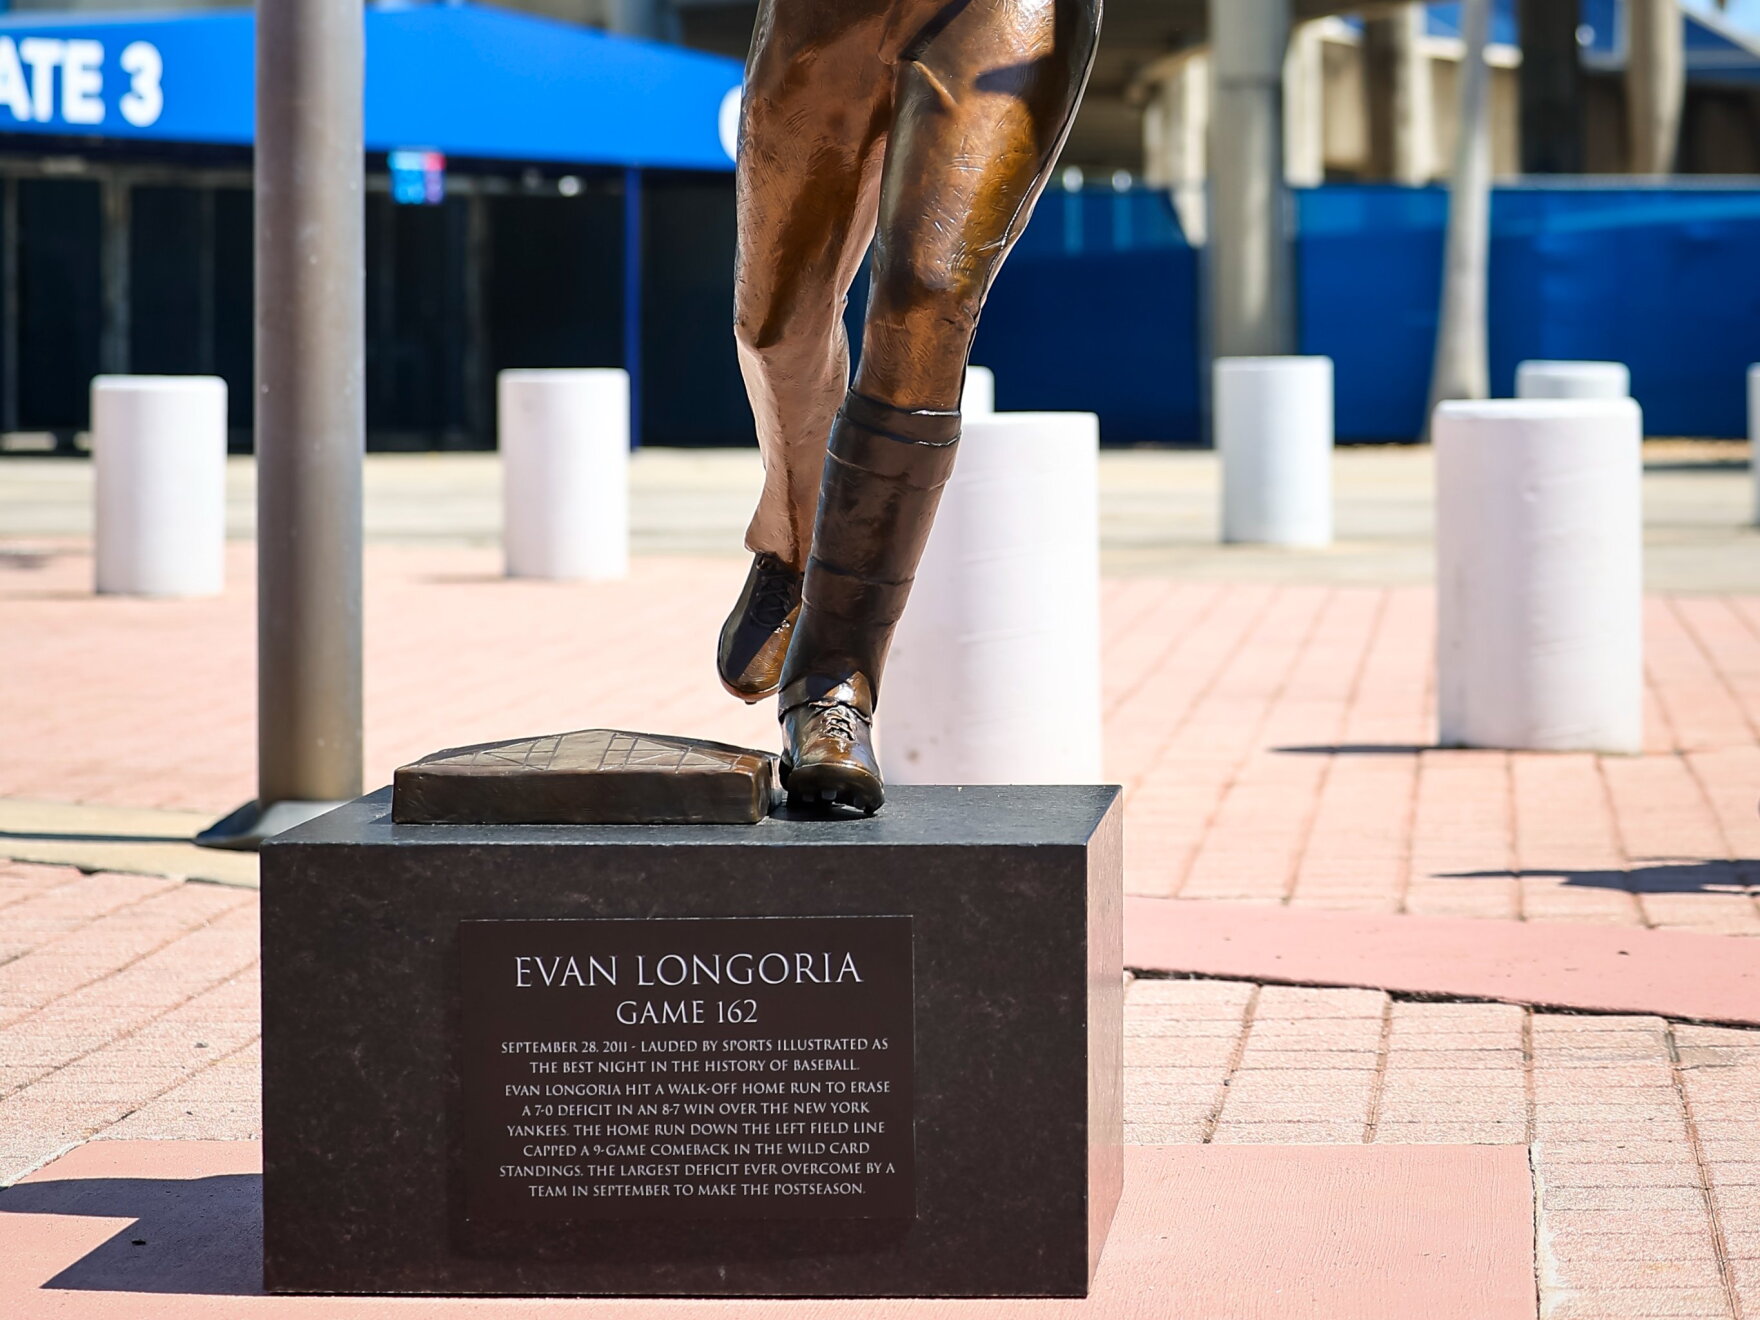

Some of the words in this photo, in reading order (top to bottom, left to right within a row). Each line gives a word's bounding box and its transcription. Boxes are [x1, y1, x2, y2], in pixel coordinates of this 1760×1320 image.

[119, 40, 164, 128] 3
[515, 956, 616, 987] EVAN
[637, 952, 863, 985] LONGORIA
[617, 999, 704, 1024] GAME
[717, 999, 757, 1024] 162
[502, 1041, 578, 1054] SEPTEMBER
[603, 1041, 627, 1053] 2011
[642, 1040, 697, 1052] LAUDED
[703, 1040, 718, 1052] BY
[723, 1039, 772, 1051] SPORTS
[778, 1039, 868, 1051] ILLUSTRATED
[872, 1038, 888, 1050] AS
[530, 1062, 557, 1074] THE
[563, 1061, 594, 1073] BEST
[599, 1061, 646, 1073] NIGHT
[652, 1060, 667, 1072] IN
[671, 1060, 699, 1072] THE
[705, 1060, 765, 1072] HISTORY
[770, 1059, 788, 1071] OF
[506, 1084, 540, 1096] EVAN
[546, 1083, 621, 1096] LONGORIA
[626, 1084, 651, 1096] HIT
[655, 1083, 664, 1095] A
[668, 1082, 737, 1095] WALK-OFF
[743, 1082, 785, 1094] HOME
[791, 1082, 820, 1094] RUN
[825, 1081, 846, 1093] TO
[851, 1081, 890, 1093] ERASE
[522, 1105, 531, 1116] A
[535, 1104, 553, 1116] 7-0
[558, 1103, 612, 1116] DEFICIT
[617, 1104, 632, 1116] IN
[638, 1104, 657, 1116] AN
[662, 1103, 680, 1115] 8-7
[684, 1103, 714, 1115] WIN
[719, 1103, 757, 1115] OVER
[761, 1102, 788, 1115] THE
[794, 1102, 826, 1115] NEW
[831, 1101, 870, 1114] YORK
[573, 1124, 601, 1136] THE
[607, 1124, 649, 1136] HOME
[655, 1123, 684, 1135] RUN
[691, 1123, 737, 1135] DOWN
[742, 1122, 770, 1135] THE
[776, 1122, 806, 1135] LEFT
[811, 1121, 848, 1134] FIELD
[854, 1121, 884, 1134] LINE
[523, 1145, 576, 1157] CAPPED
[581, 1145, 589, 1156] A
[594, 1144, 646, 1156] 9-GAME
[651, 1143, 730, 1156] COMEBACK
[735, 1143, 750, 1155] IN
[755, 1143, 782, 1155] THE
[788, 1143, 825, 1155] WILD
[830, 1142, 869, 1154] CARD
[587, 1164, 614, 1177] THE
[621, 1164, 680, 1177] LARGEST
[685, 1164, 739, 1176] DEFICIT
[745, 1163, 778, 1175] EVER
[781, 1163, 860, 1175] OVERCOME
[867, 1162, 881, 1174] BY
[886, 1162, 895, 1174] A
[529, 1185, 567, 1197] TEAM
[573, 1185, 588, 1196] IN
[594, 1184, 670, 1197] SEPTEMBER
[674, 1184, 693, 1196] TO
[698, 1184, 736, 1196] MAKE
[741, 1183, 768, 1195] THE
